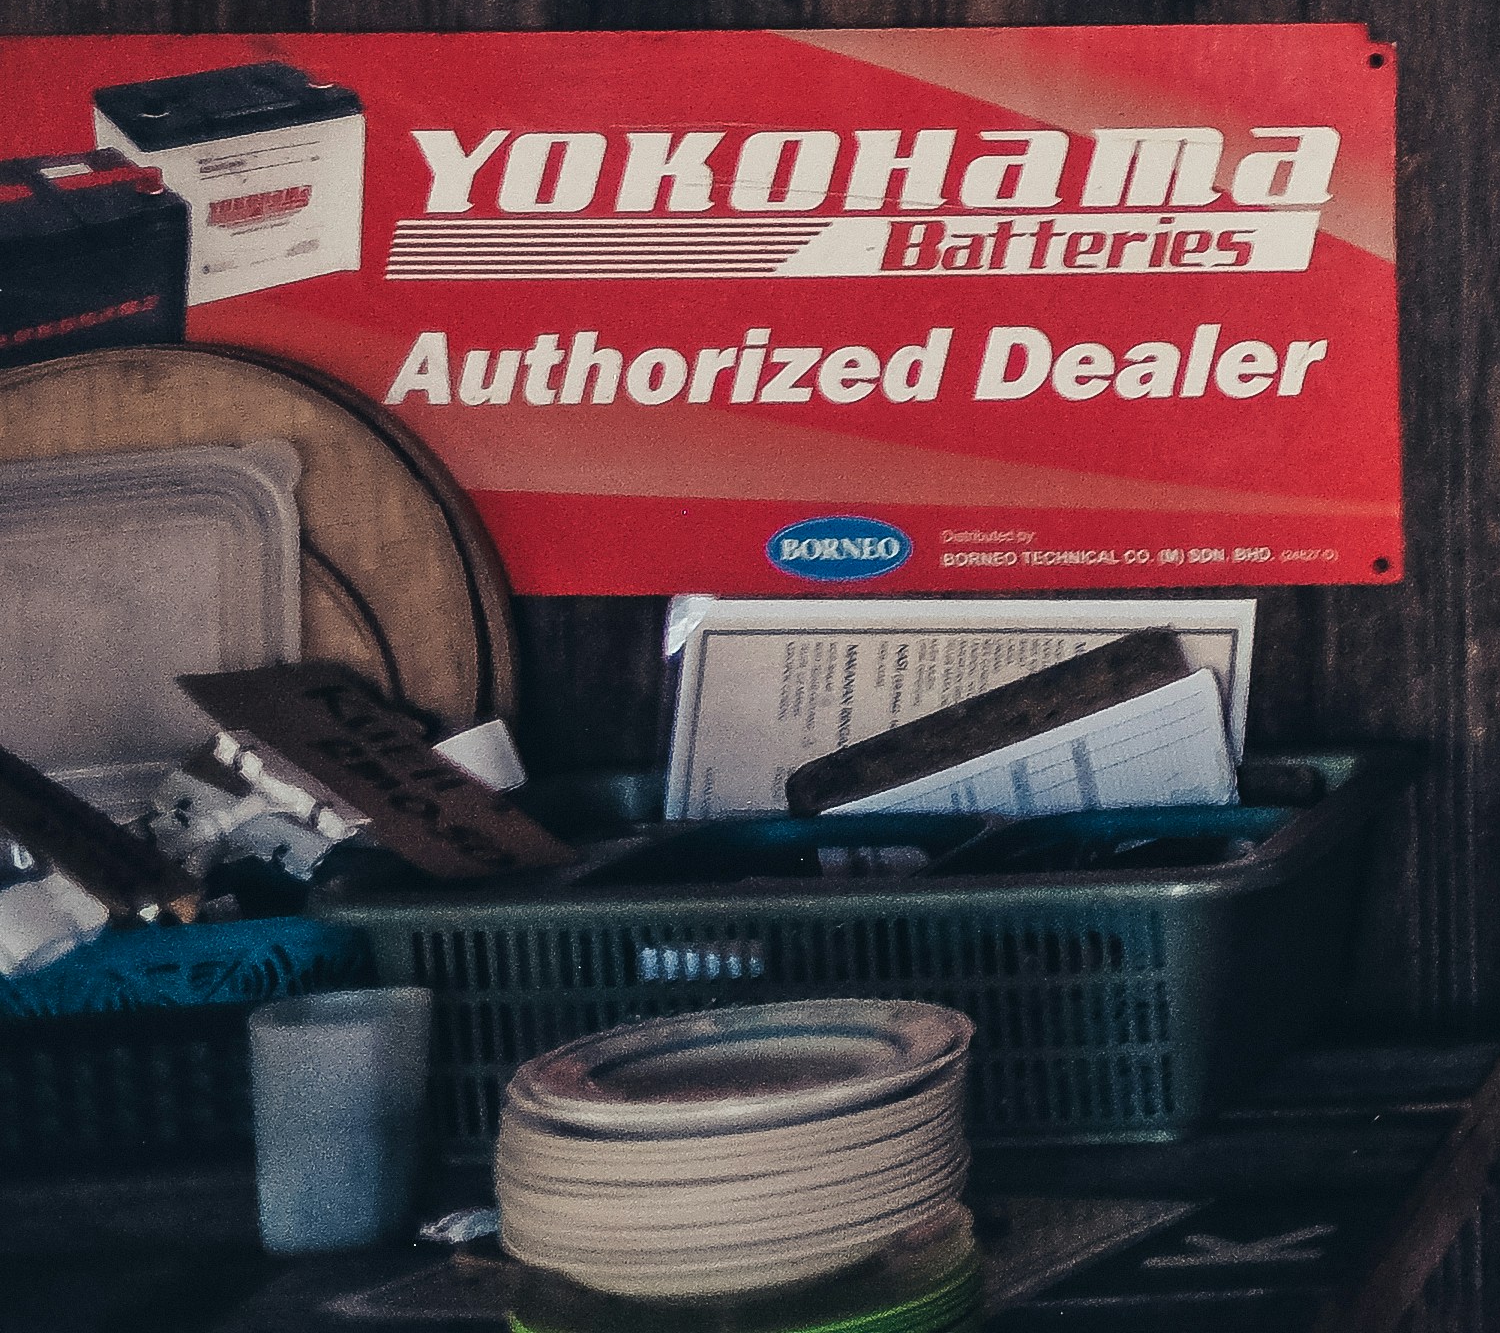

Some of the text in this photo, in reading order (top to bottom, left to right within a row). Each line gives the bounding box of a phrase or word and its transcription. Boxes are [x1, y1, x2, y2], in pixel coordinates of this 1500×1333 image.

[881, 217, 1257, 275] Batteries
[384, 324, 1329, 407] Authorized Dealer
[779, 536, 901, 563] BORNEO
[941, 551, 1018, 567] BORNEO
[1021, 549, 1121, 566] TECHNICAL
